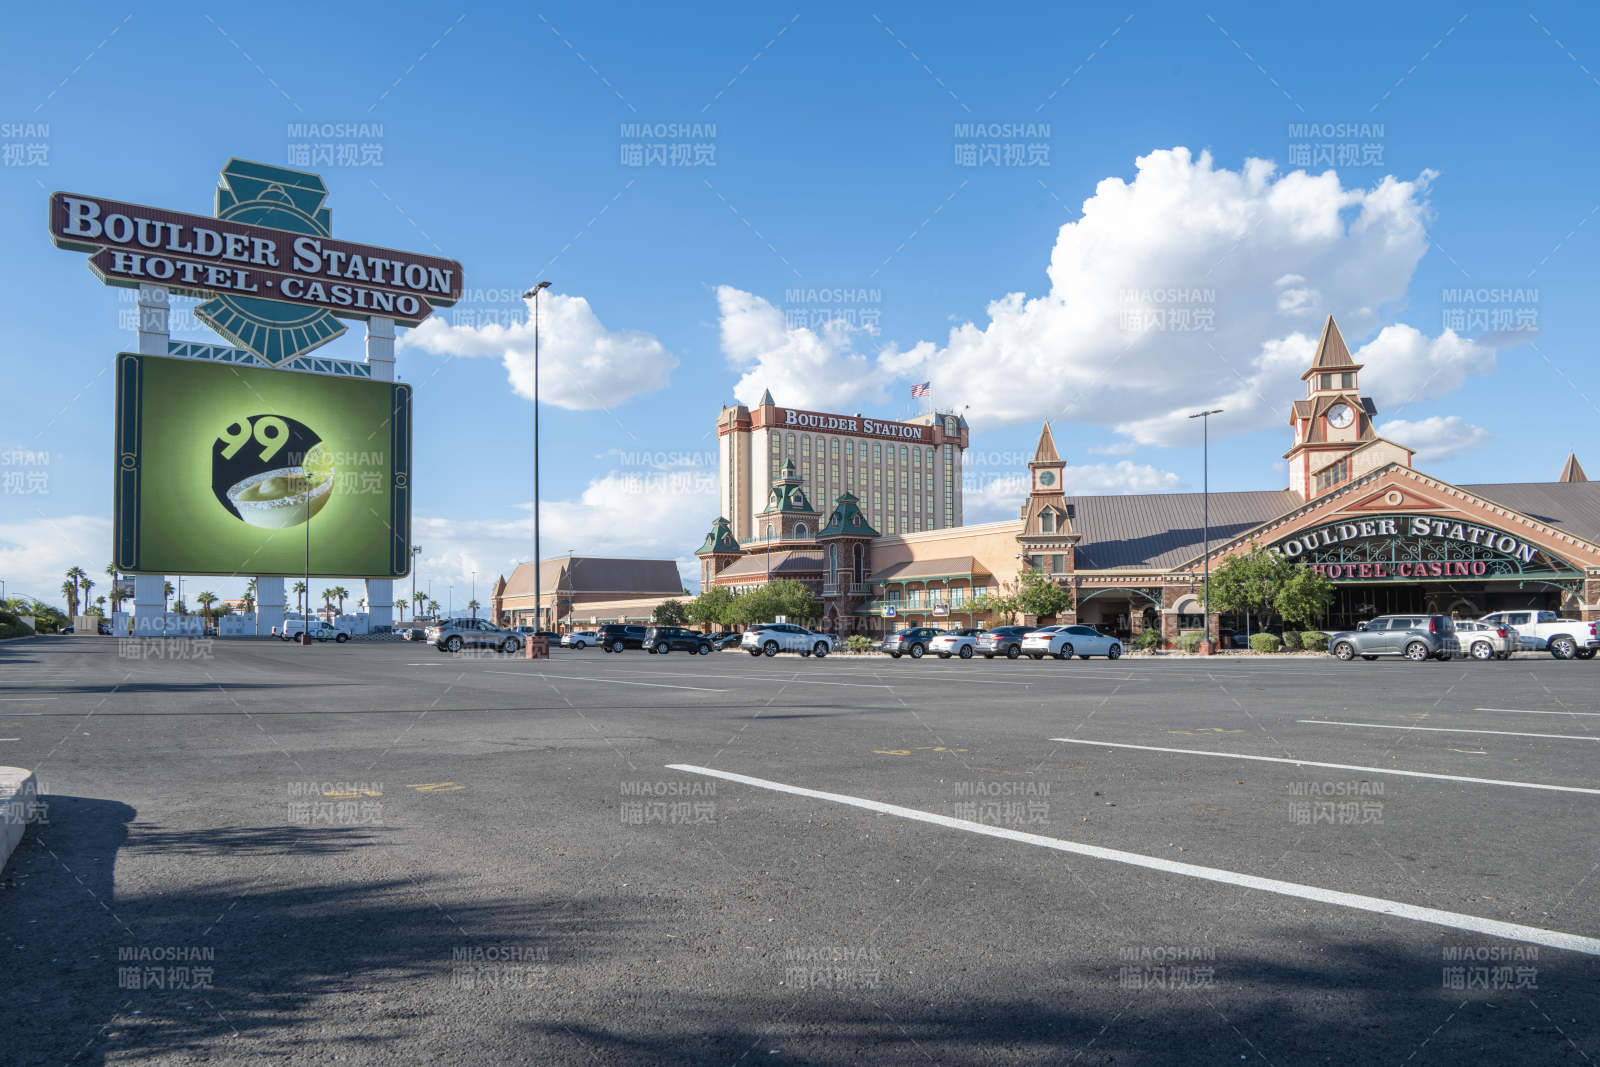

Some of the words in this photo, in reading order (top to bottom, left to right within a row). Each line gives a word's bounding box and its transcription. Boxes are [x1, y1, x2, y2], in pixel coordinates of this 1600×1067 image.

[63, 197, 279, 266] BOULDER
[293, 237, 453, 294] STATION
[111, 251, 257, 292] HOTEL
[280, 278, 420, 315] CASINO
[219, 416, 289, 463] 99
[785, 410, 857, 432] BOULDER
[863, 419, 922, 439] STATION
[1412, 517, 1538, 562] STATION
[1313, 563, 1387, 579] HOTEL
[1400, 561, 1486, 577] CASINO
